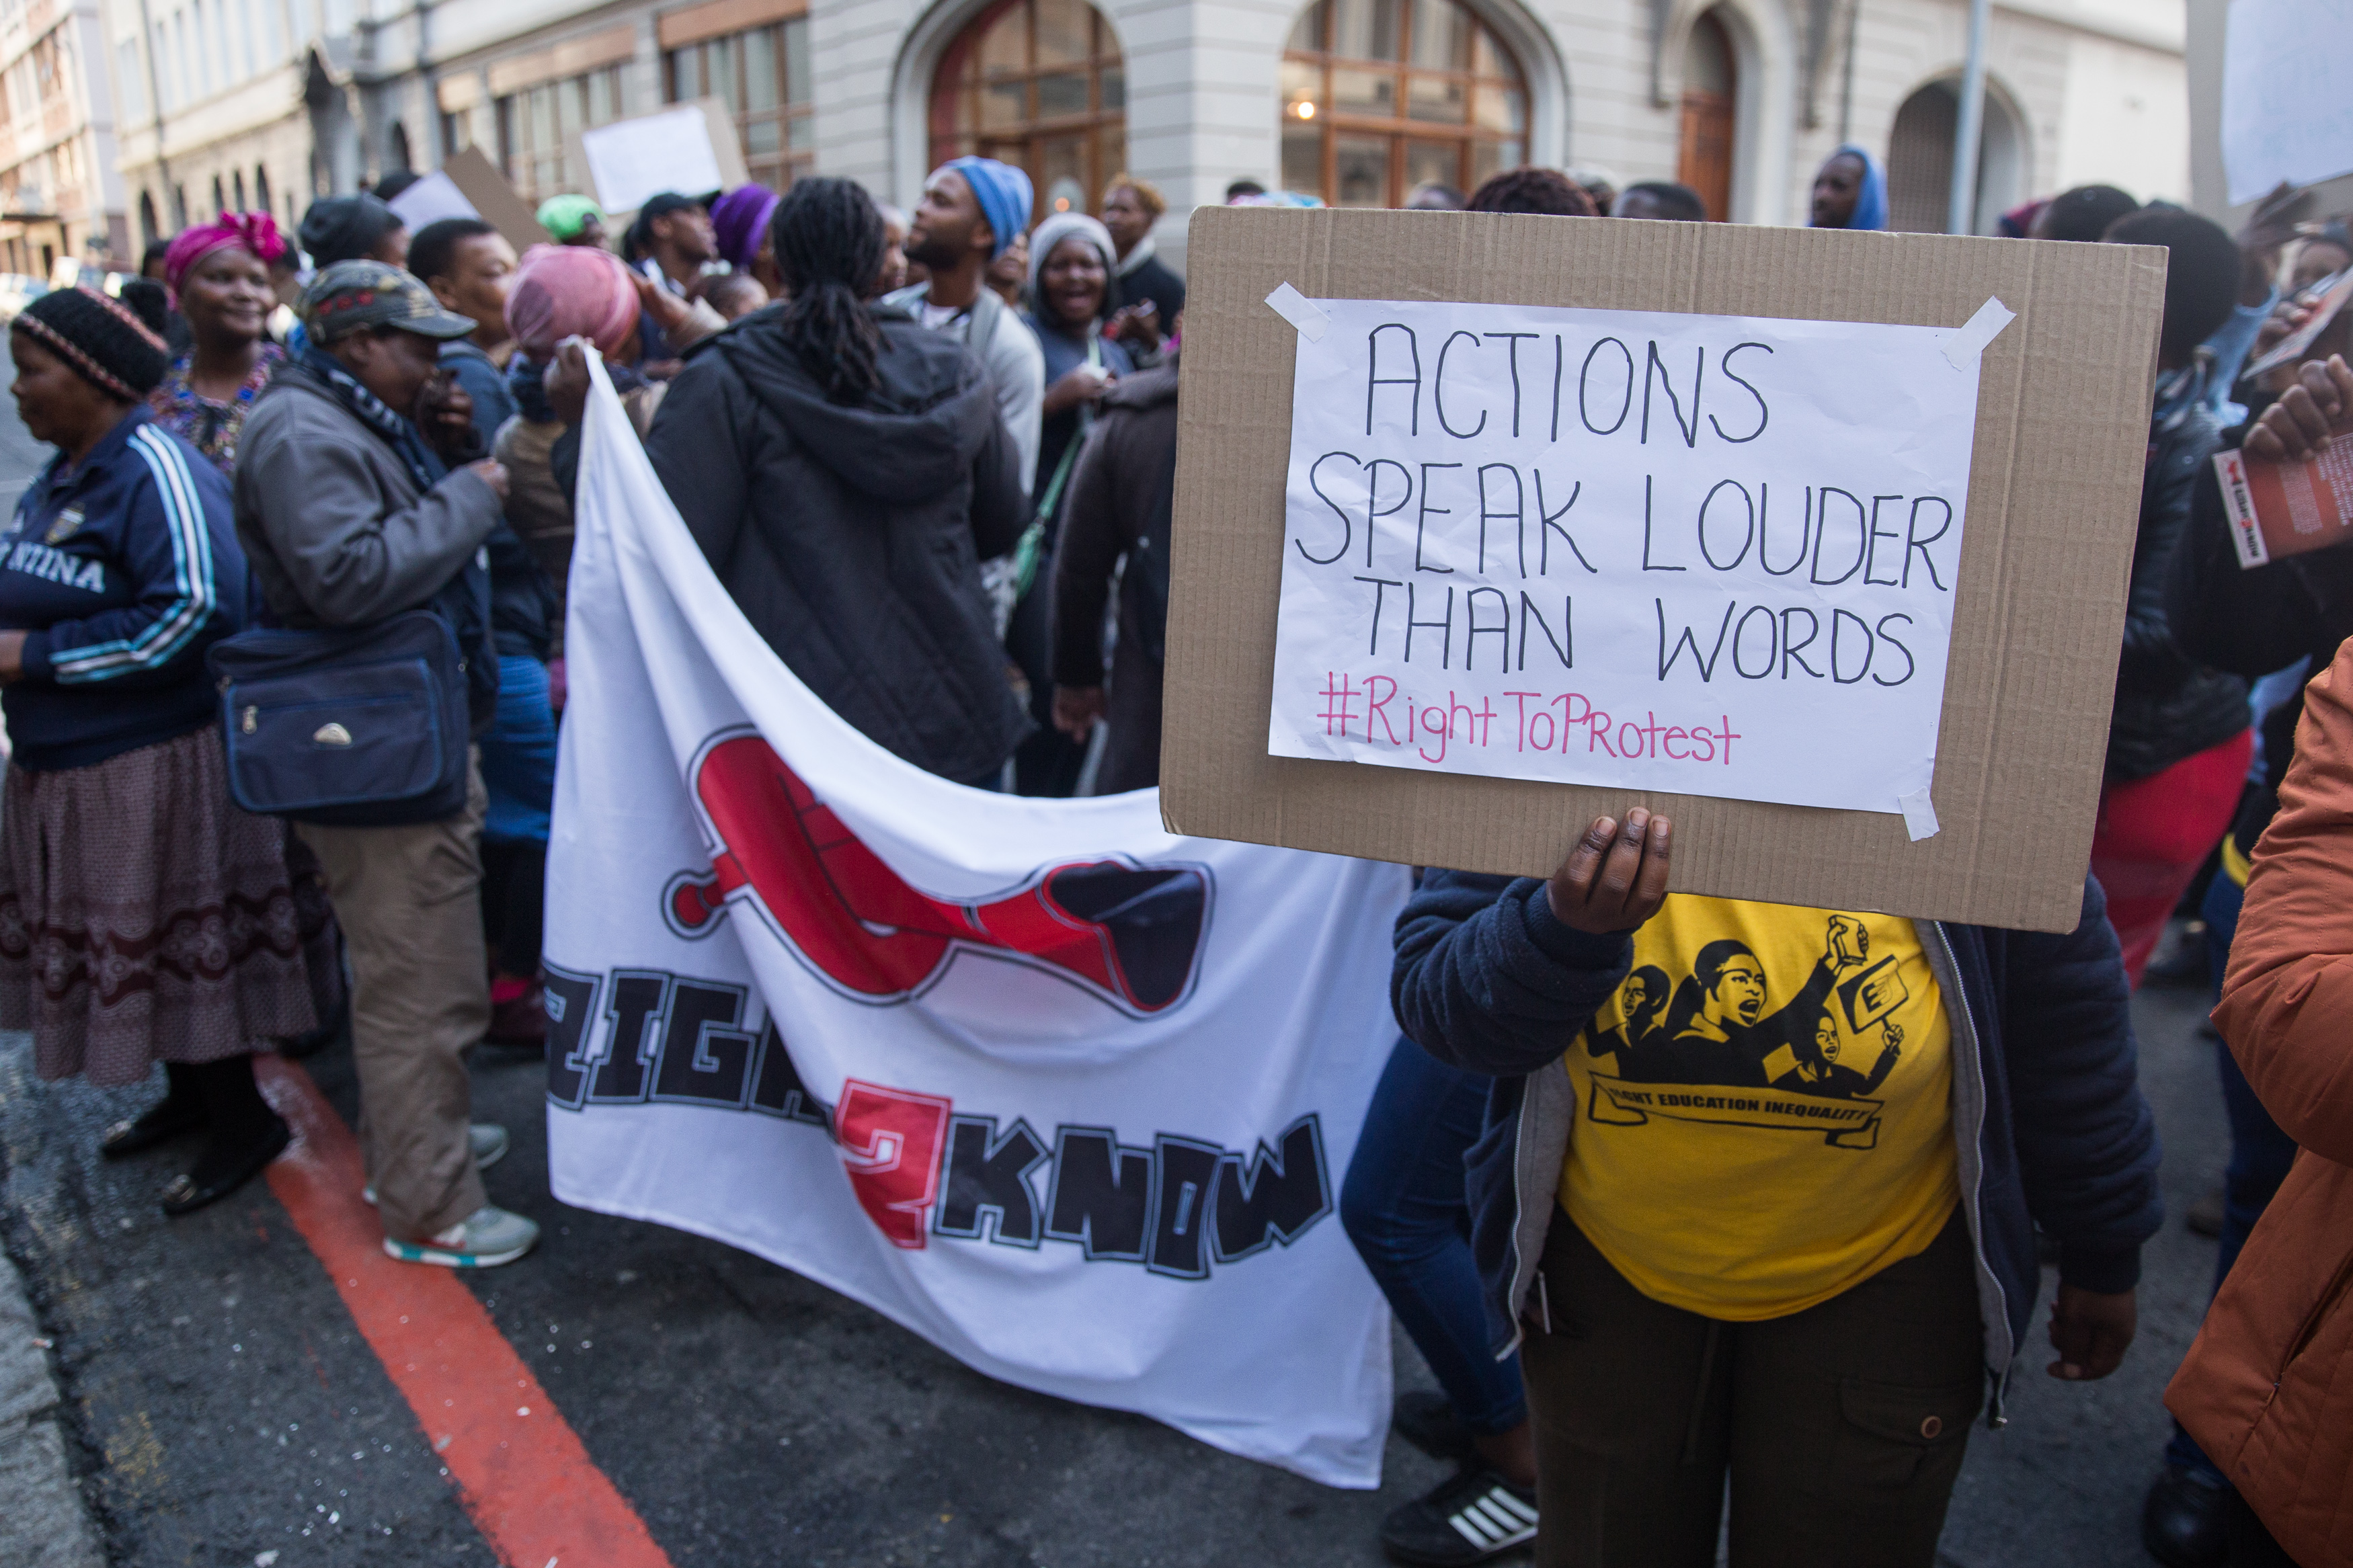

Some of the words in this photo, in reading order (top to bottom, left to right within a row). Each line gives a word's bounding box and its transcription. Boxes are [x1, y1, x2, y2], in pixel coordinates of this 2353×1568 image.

[1367, 323, 1774, 449] ACTIONS
[1295, 451, 1598, 580] SPEAK
[1642, 474, 1953, 592] LOUDER
[1353, 576, 1573, 674] THAN
[1655, 597, 1915, 687] WORDS
[1659, 1093, 1759, 1112] EDUCATION
[1765, 1101, 1870, 1121] INEQUALITY
